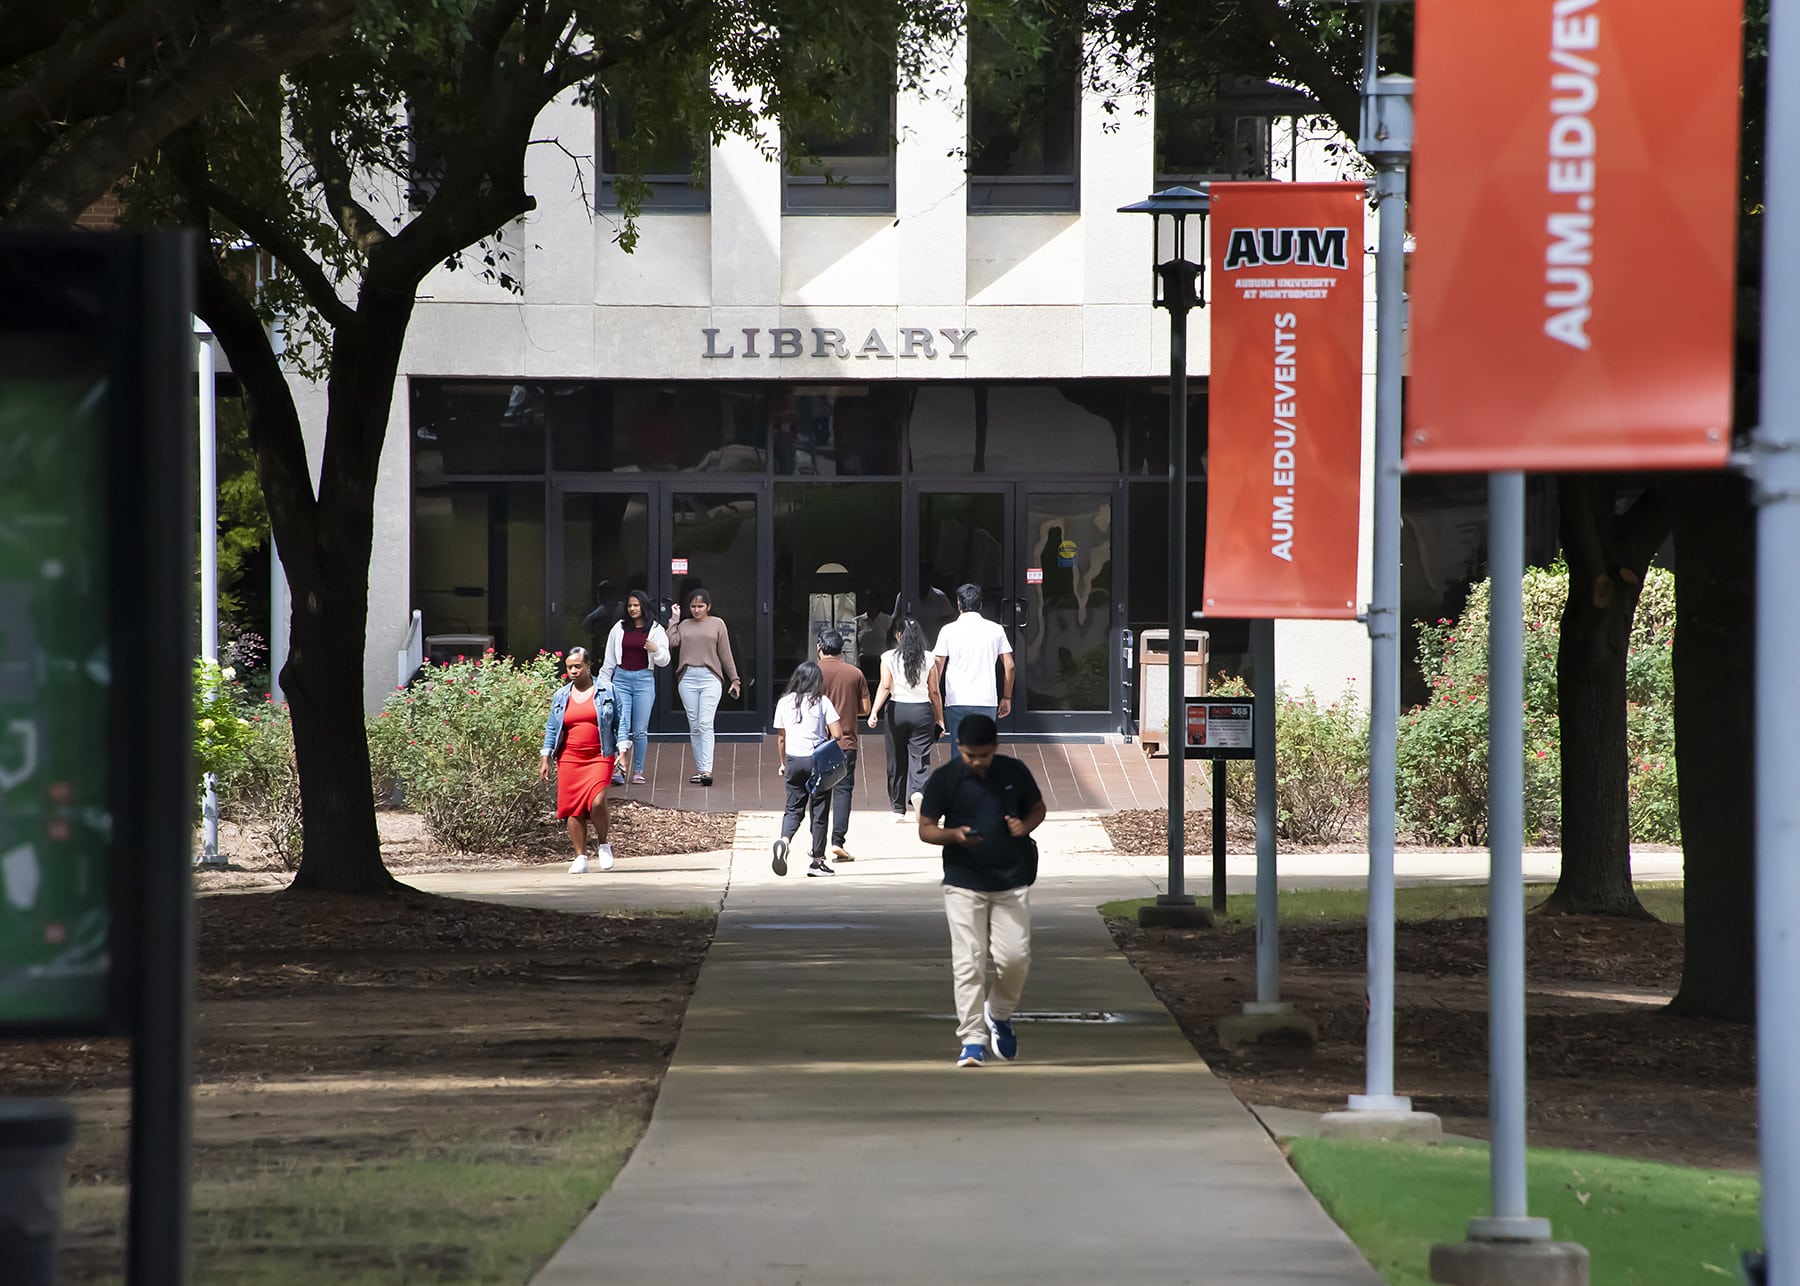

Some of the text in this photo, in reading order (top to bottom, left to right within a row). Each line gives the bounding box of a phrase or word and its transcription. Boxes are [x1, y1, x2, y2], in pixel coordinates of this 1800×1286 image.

[1223, 227, 1348, 271] AUM
[1235, 278, 1337, 288] AUBURN UNIVERSITY
[1243, 289, 1328, 299] AT MONTGOMERY
[701, 327, 977, 360] LIBRARY
[1271, 312, 1297, 562] AUM.EDU/EVENTS
